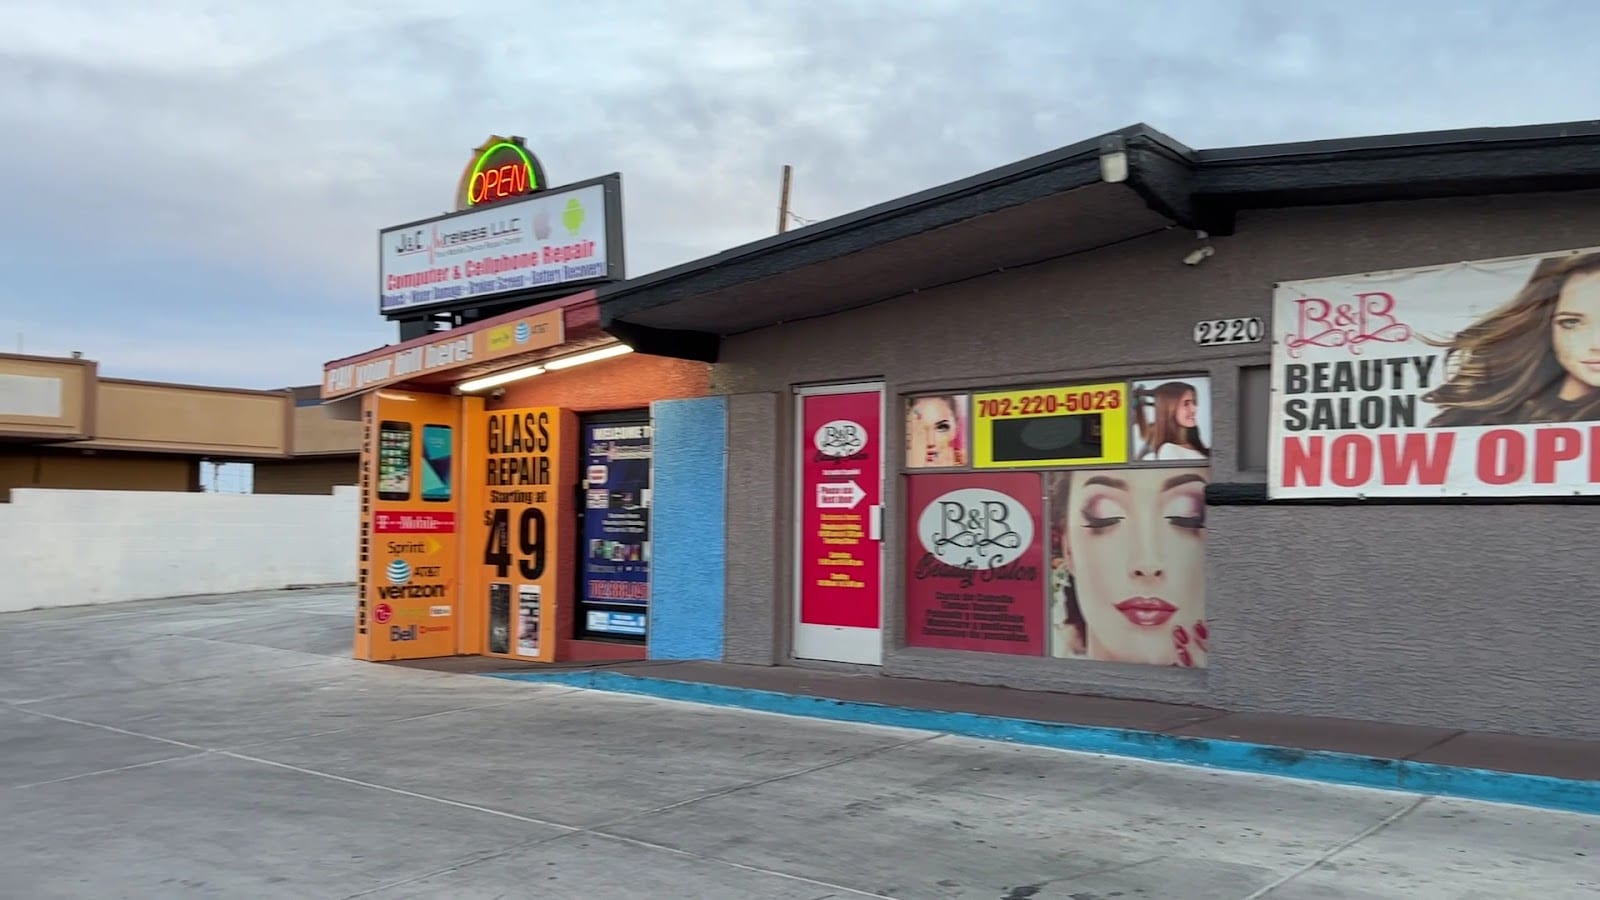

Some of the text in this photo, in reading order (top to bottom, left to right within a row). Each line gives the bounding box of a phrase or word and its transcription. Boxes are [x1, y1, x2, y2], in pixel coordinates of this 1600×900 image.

[469, 163, 529, 203] OPEN
[490, 217, 521, 236] LLC
[387, 240, 596, 290] Computer & Cellphone Repair
[1199, 318, 1260, 344] 2220
[1285, 292, 1412, 360] B&B
[1285, 355, 1437, 395] BEAUTY
[978, 390, 1121, 417] 702-220-5023
[1284, 395, 1417, 431] SALON
[488, 412, 549, 454] GLASS
[487, 456, 551, 486] REPAIR
[1282, 426, 1600, 488] NOW OP
[490, 490, 547, 504] Starting at
[931, 500, 1022, 556] B&B
[387, 541, 425, 557] Sprint
[414, 566, 442, 577] AT&T
[915, 552, 1037, 589] Beauty Salon
[377, 581, 446, 599] verizon
[390, 624, 417, 641] Bell
